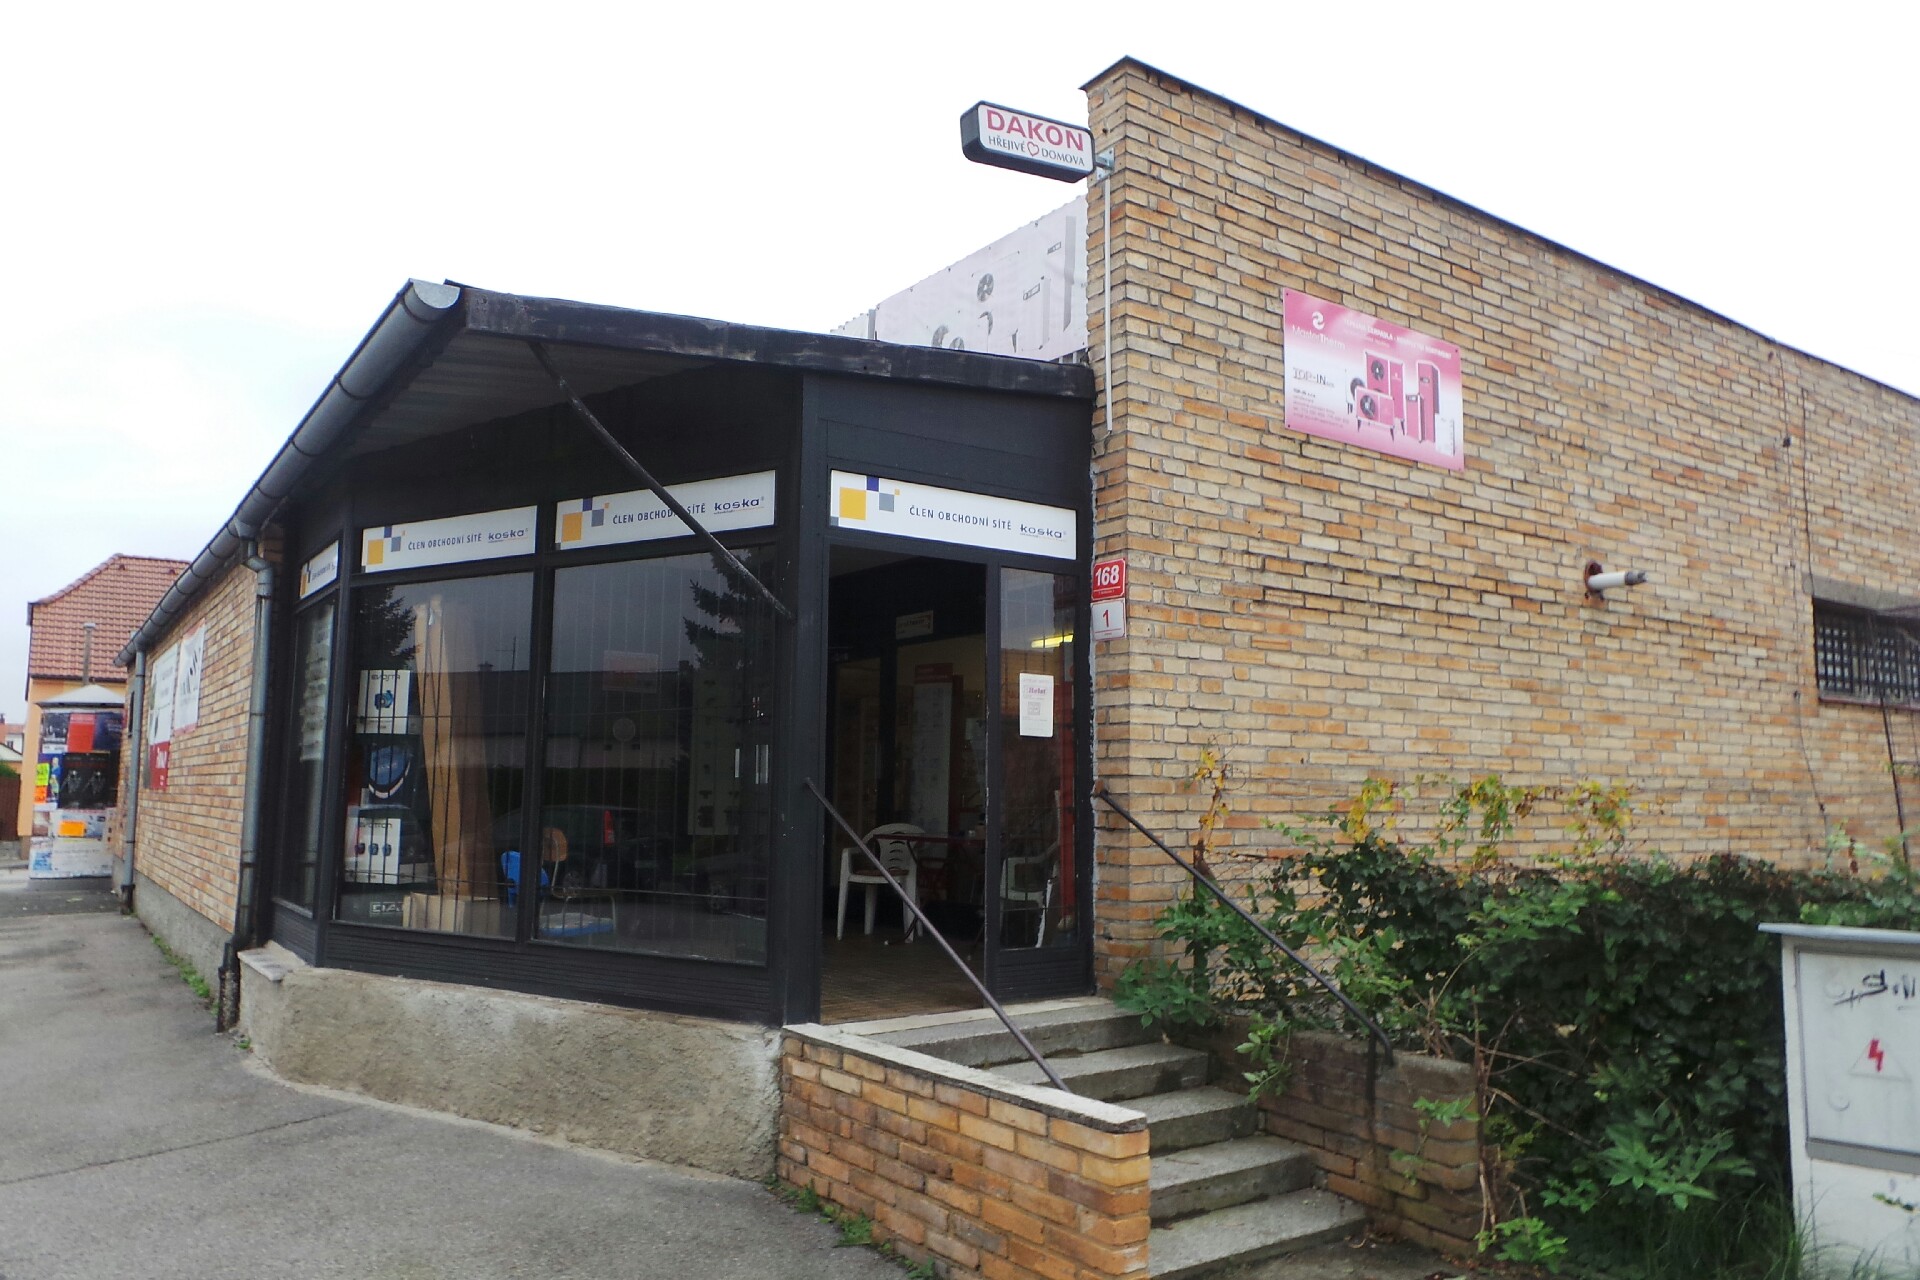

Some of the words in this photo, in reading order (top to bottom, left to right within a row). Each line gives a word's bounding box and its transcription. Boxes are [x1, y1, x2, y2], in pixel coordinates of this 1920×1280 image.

[987, 109, 1084, 151] DAKON
[988, 135, 1026, 153] HŘEJIVÉ
[1041, 147, 1085, 166] DOMOVA
[612, 513, 634, 524] ČLEN
[638, 507, 674, 522] OBCHOD
[714, 498, 760, 511] koska
[909, 505, 934, 519] ČLEN
[938, 512, 989, 527] OBCHODNÍ
[992, 519, 1012, 531] SÍTĚ
[1020, 523, 1062, 538] koska
[408, 541, 425, 551] ČLEN
[428, 534, 464, 548] OBCHODNÍ
[488, 528, 525, 541] koska
[1095, 564, 1119, 586] 168
[1102, 609, 1109, 628] 1
